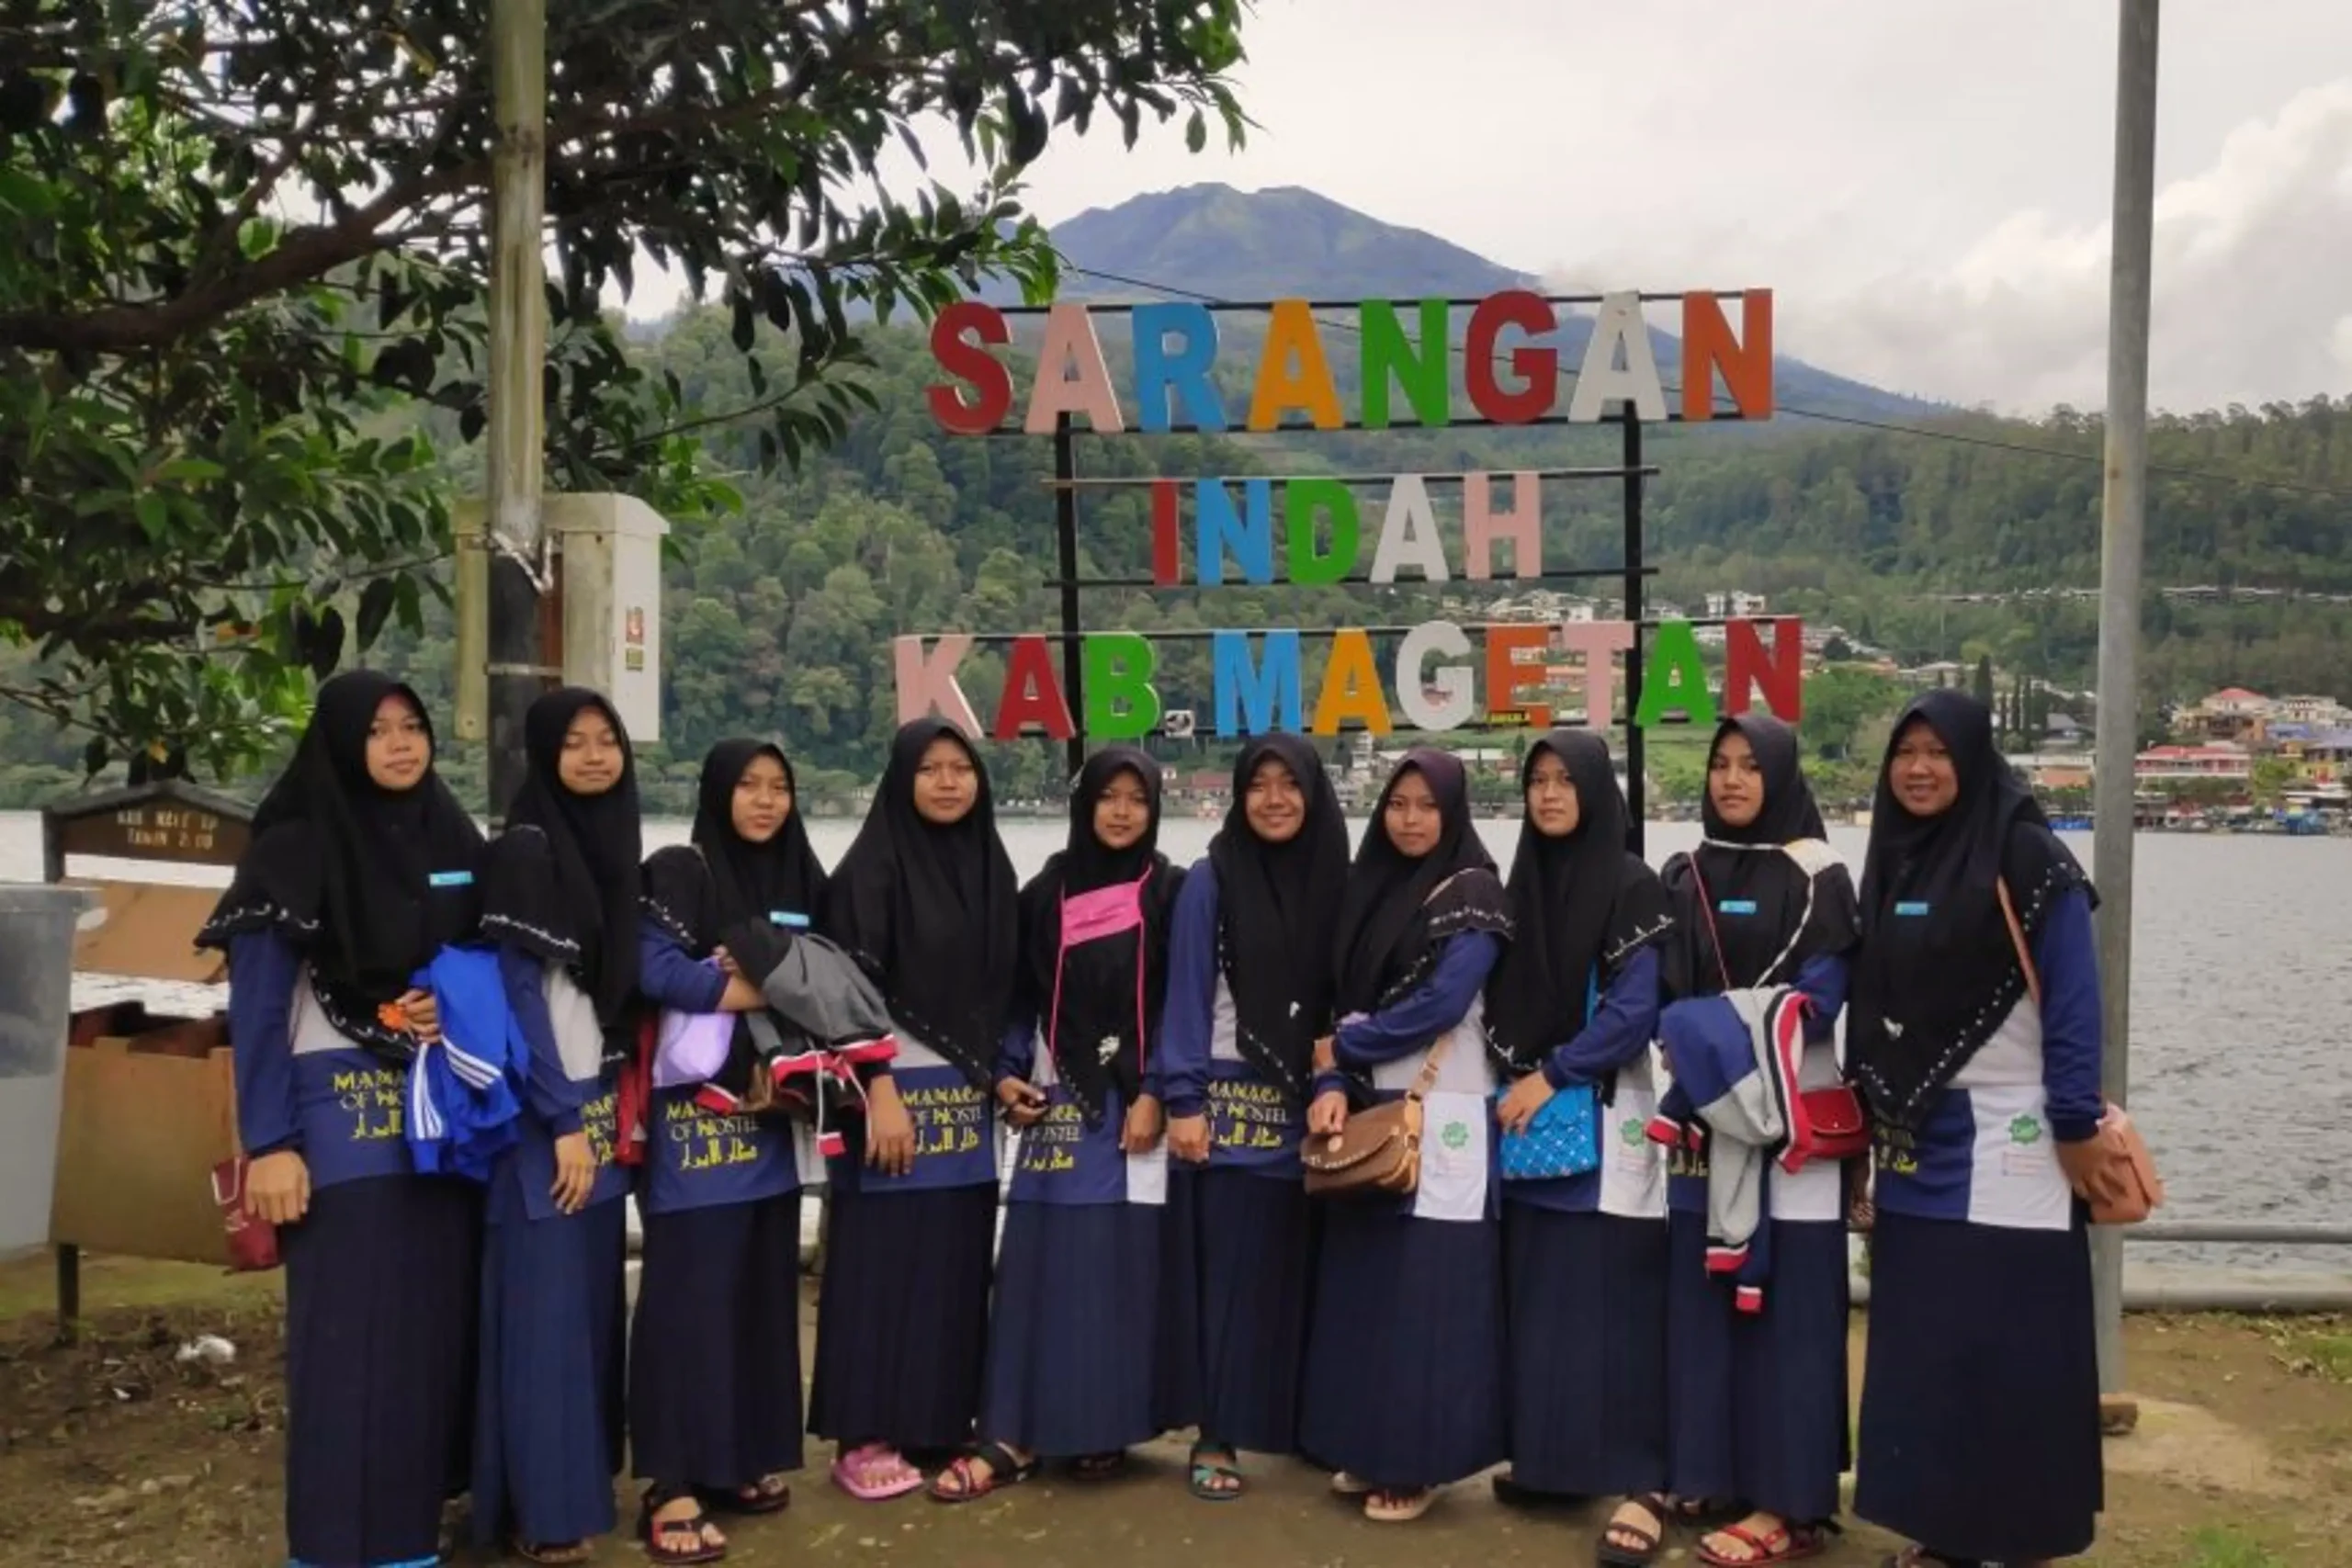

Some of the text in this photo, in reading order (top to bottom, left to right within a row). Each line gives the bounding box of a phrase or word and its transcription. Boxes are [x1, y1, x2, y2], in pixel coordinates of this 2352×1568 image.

[929, 288, 1773, 434] SARANGAN
[1150, 471, 1543, 586] INDAH
[1213, 615, 1802, 738] MAGETAN
